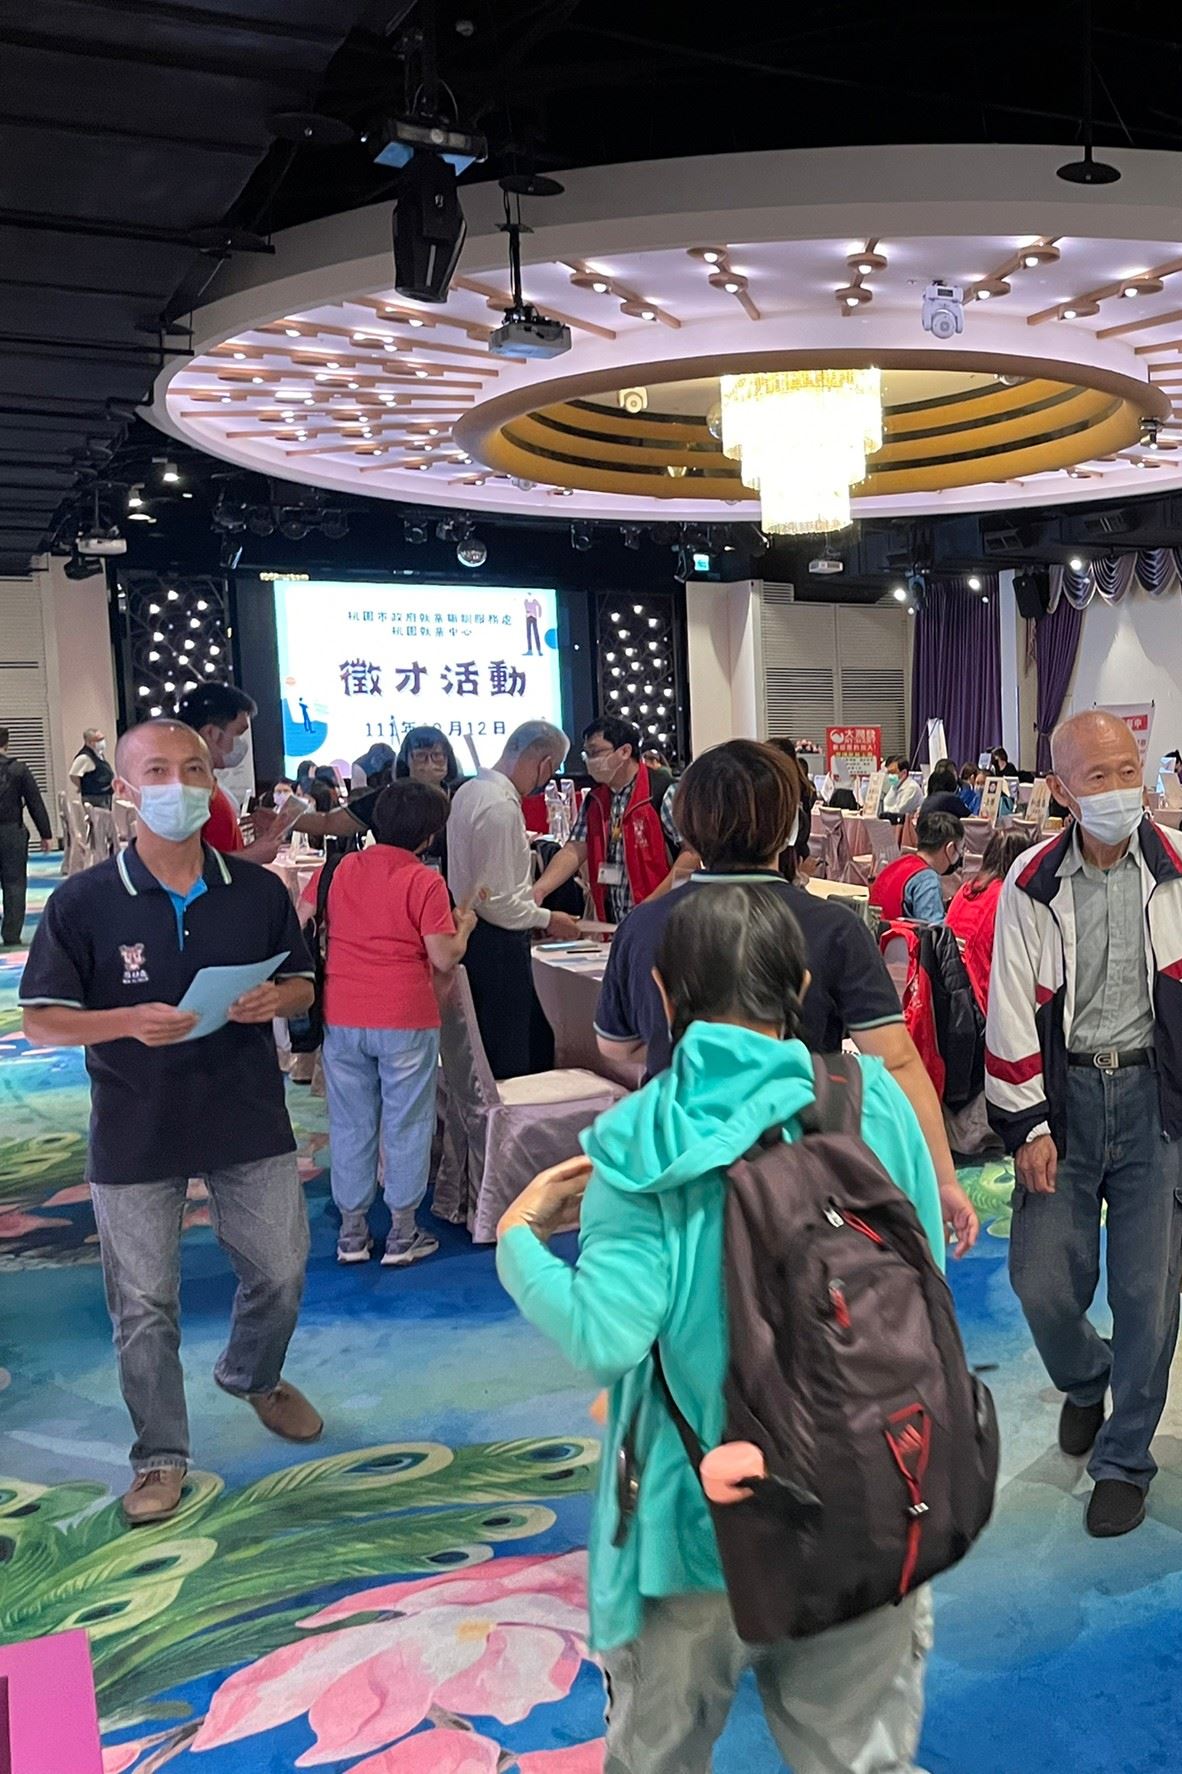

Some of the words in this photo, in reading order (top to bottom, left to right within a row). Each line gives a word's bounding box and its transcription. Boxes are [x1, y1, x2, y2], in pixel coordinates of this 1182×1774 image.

[339, 657, 527, 697] 徵才活動
[366, 720, 506, 737] 111年月12日
